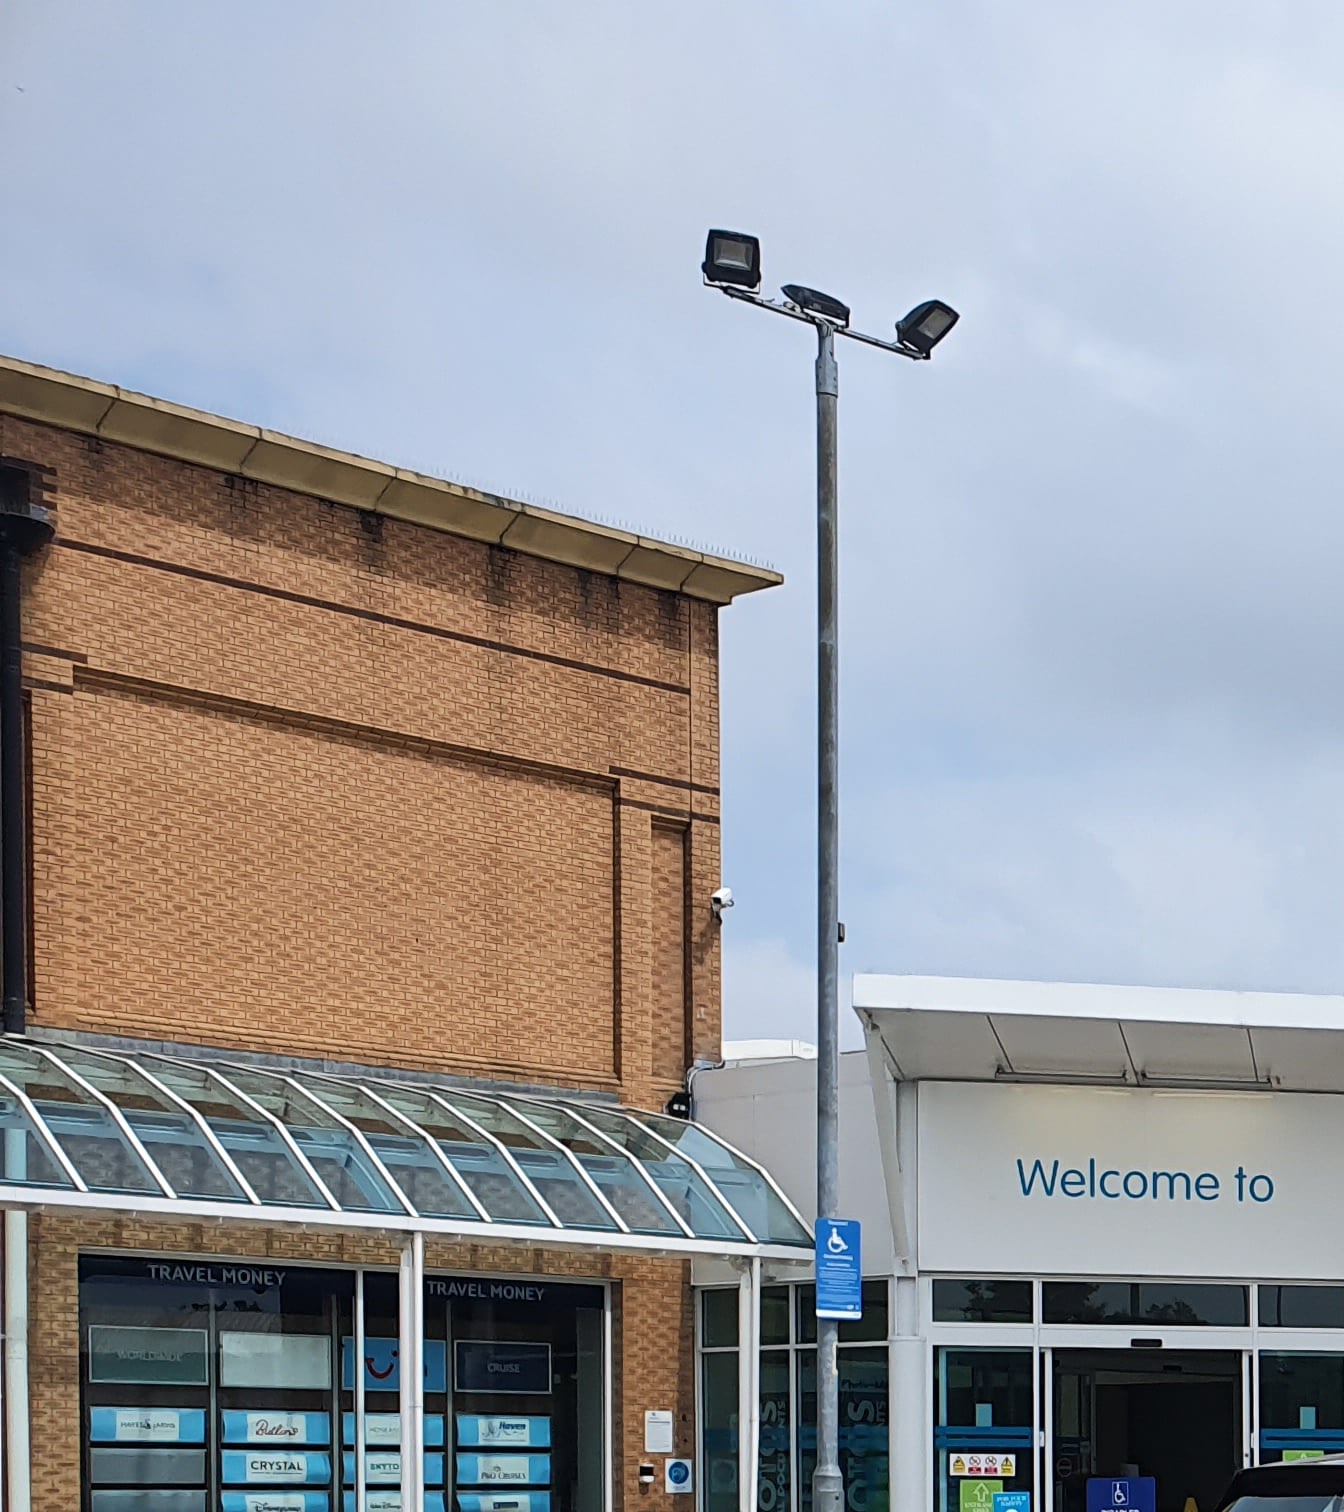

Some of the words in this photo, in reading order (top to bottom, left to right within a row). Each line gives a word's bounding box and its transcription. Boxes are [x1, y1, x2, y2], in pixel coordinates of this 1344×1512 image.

[1017, 1157, 1220, 1201] Welcome
[1235, 1165, 1274, 1203] to
[150, 1264, 216, 1283] TRAVEL
[222, 1269, 286, 1286] MONEY
[427, 1280, 487, 1298] TRAVEL
[491, 1285, 544, 1301] MONEY
[487, 1363, 521, 1373] CRUISE
[250, 1461, 303, 1471] CRYSTAL
